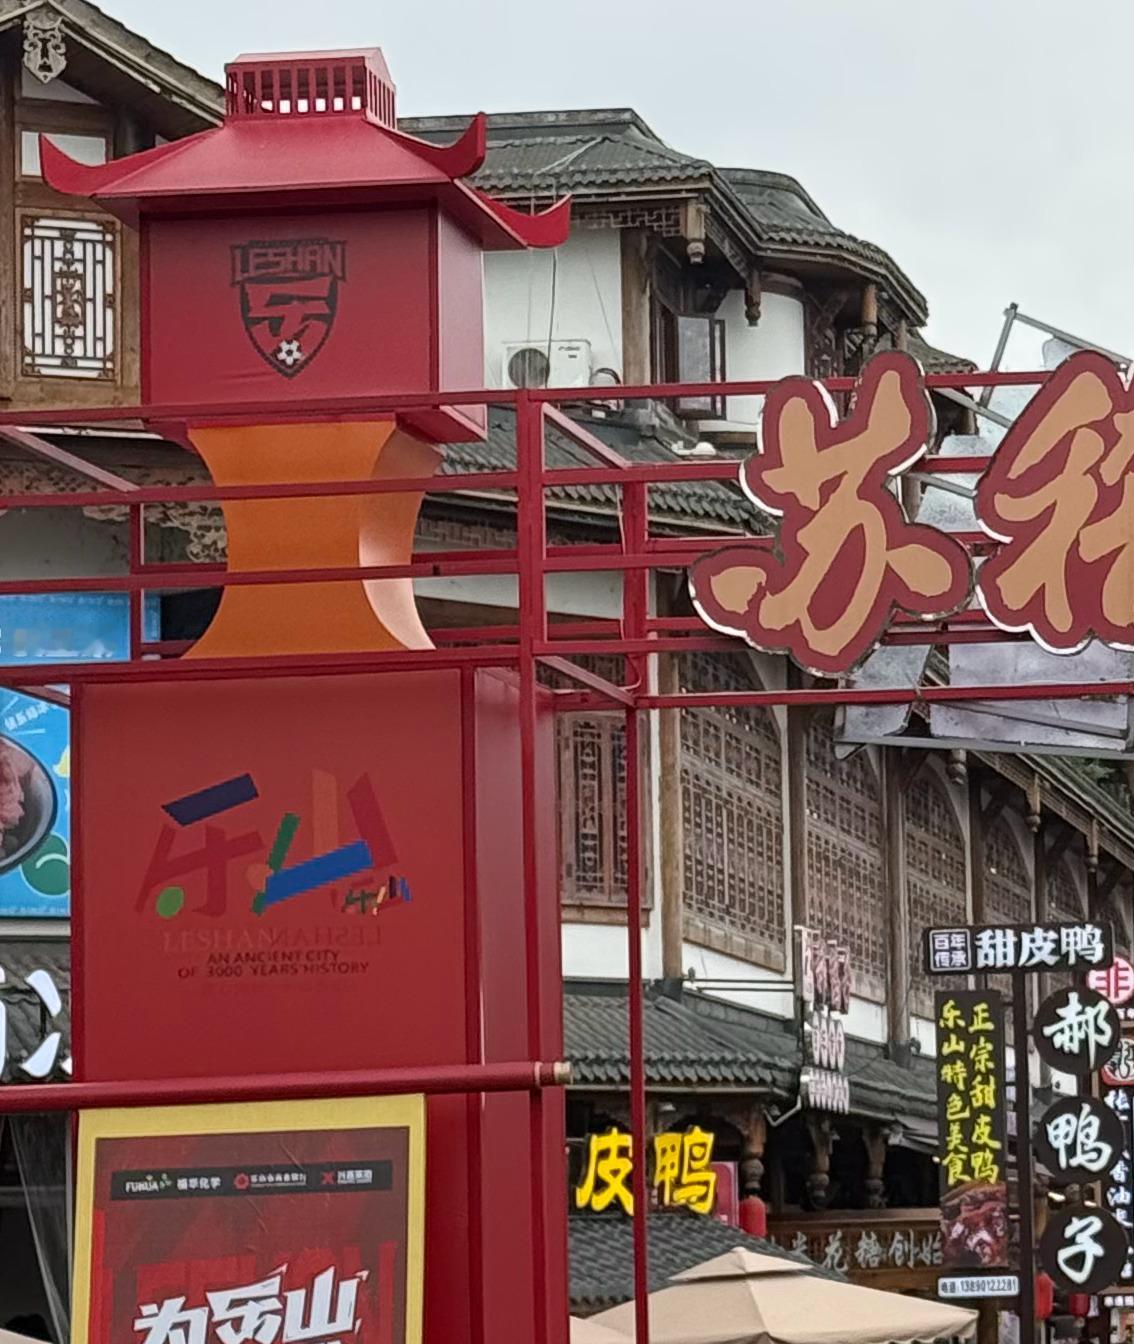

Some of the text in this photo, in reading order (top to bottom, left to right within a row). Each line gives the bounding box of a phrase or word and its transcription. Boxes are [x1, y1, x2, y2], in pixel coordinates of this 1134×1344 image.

[177, 961, 369, 979] OF 3000 YEARS HISTORY
[207, 950, 340, 965] AN ANCIENT CITY
[974, 923, 1105, 969] 甜皮鸭
[939, 999, 972, 1186] 乐山特色美食
[967, 1002, 1002, 1185] 正宗甜皮鸭
[576, 1125, 717, 1217] 皮鸭
